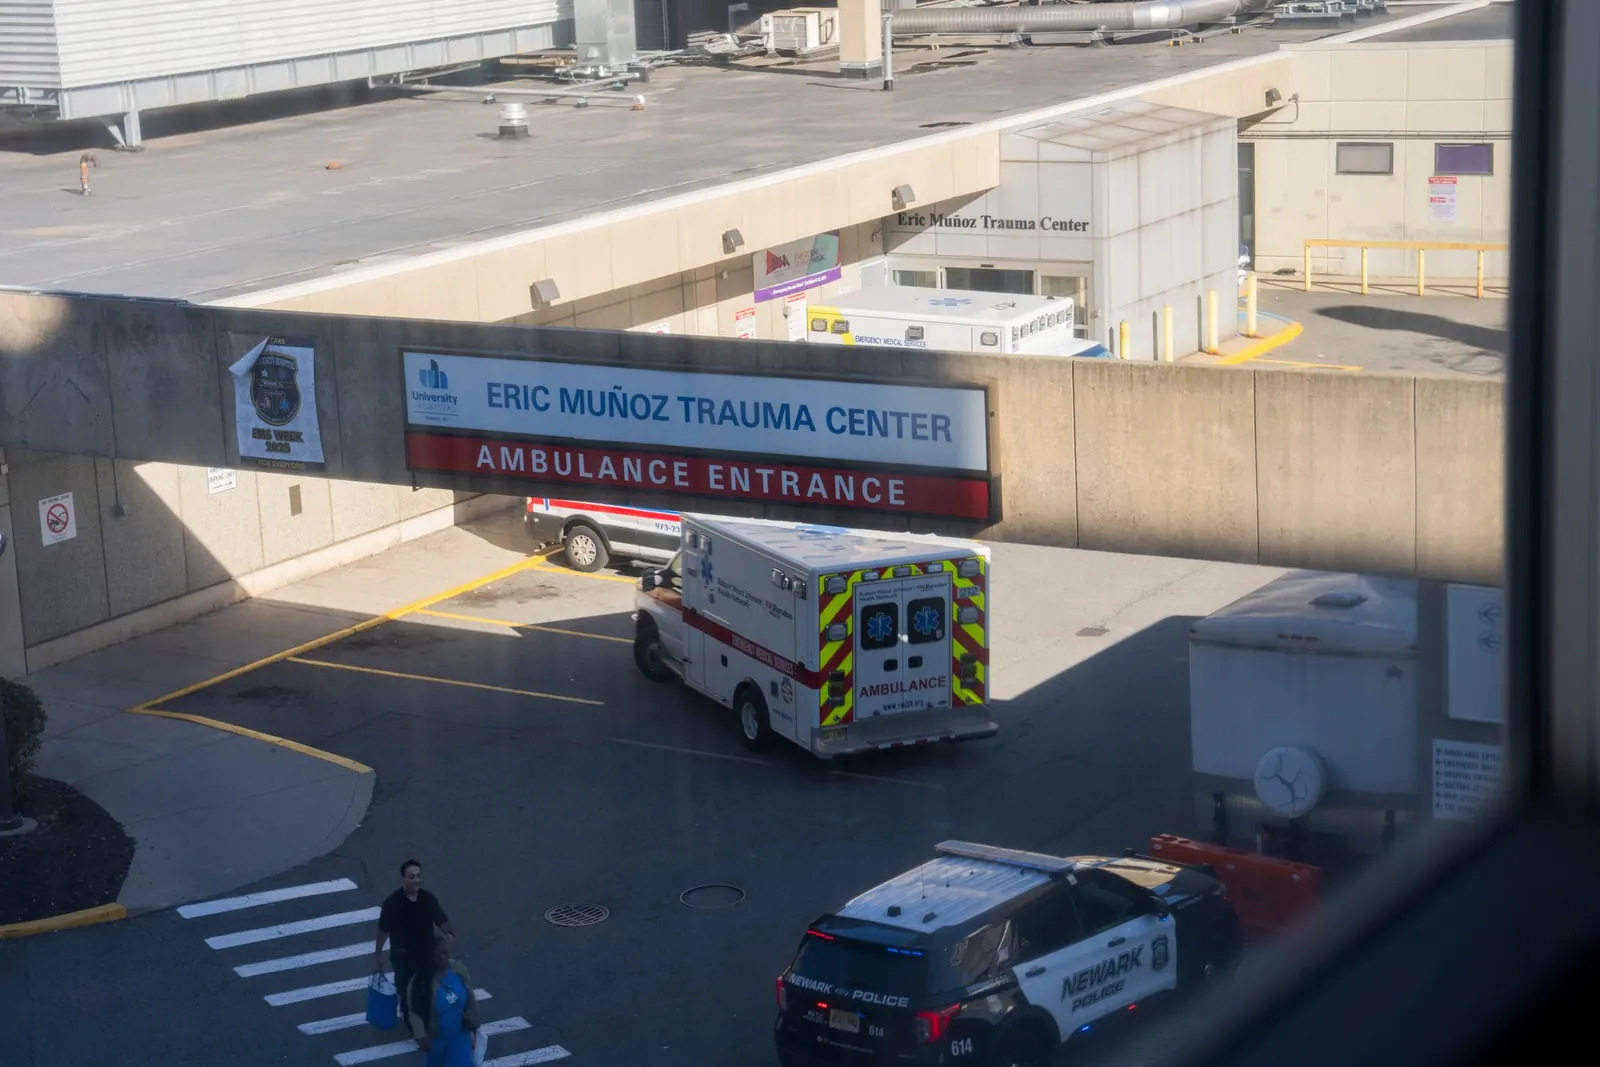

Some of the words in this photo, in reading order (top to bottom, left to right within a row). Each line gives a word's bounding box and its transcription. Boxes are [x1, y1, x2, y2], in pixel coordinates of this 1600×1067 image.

[898, 212, 926, 227] Eric
[929, 213, 977, 229] Muñoz
[982, 215, 1035, 231] Trauma
[1040, 217, 1090, 232] Center
[855, 335, 882, 344] EMERGENCY
[884, 338, 903, 346] MEDICAL
[904, 339, 927, 348] SERVICES
[412, 391, 458, 406] University
[487, 382, 550, 413] ERIC
[560, 385, 670, 422] MUÑOZ
[677, 396, 817, 432] TRAUMA
[826, 406, 953, 443] CENTER
[252, 427, 272, 440] EMS
[476, 444, 689, 487] AMBULANCE
[708, 464, 906, 505] ENTRANCE
[859, 676, 946, 699] AMBULANCE
[1061, 943, 1146, 1002] NEWARK
[789, 972, 833, 993] NEWARK
[852, 989, 910, 1008] POLICE
[1072, 978, 1126, 1012] POLICE
[868, 1024, 884, 1038] 614
[951, 1037, 973, 1057] 614
